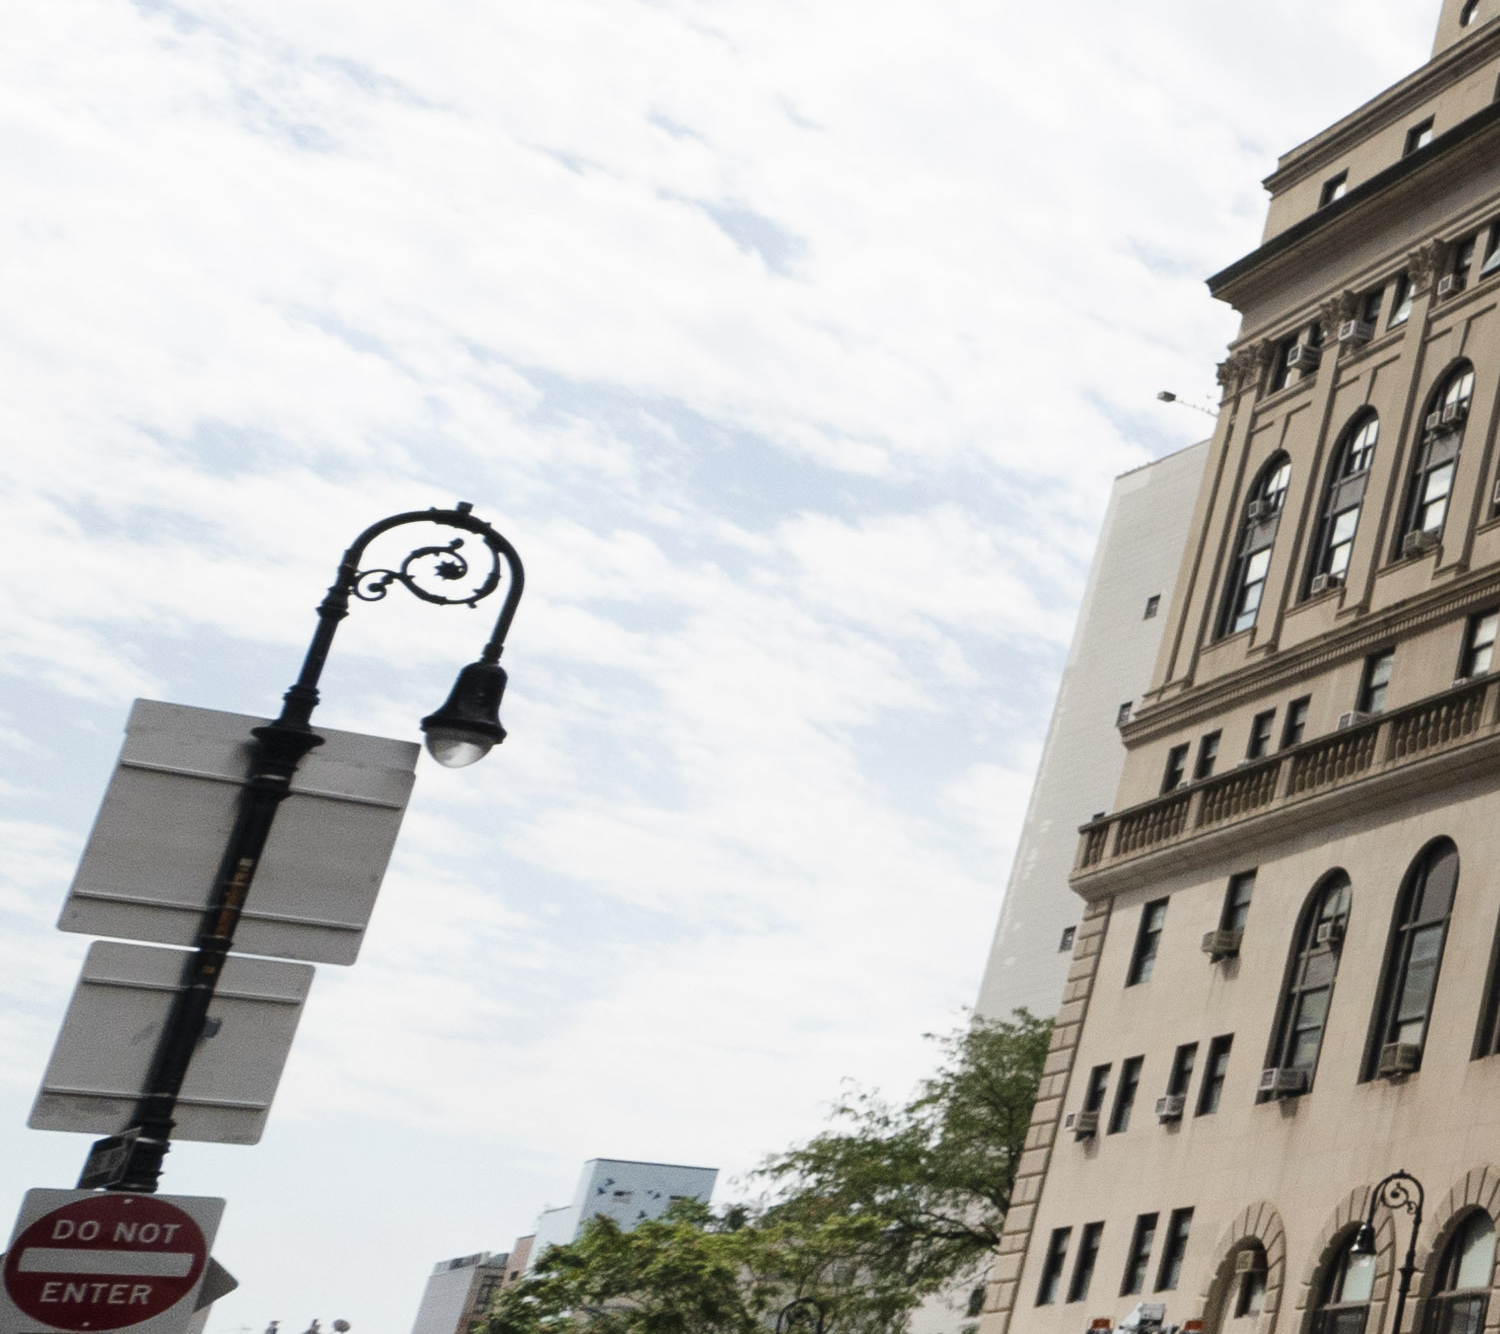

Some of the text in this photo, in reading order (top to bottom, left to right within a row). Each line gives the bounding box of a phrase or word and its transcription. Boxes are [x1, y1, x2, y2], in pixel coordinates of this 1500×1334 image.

[51, 1219, 182, 1243] DO NOT
[40, 1281, 152, 1305] ENTER
